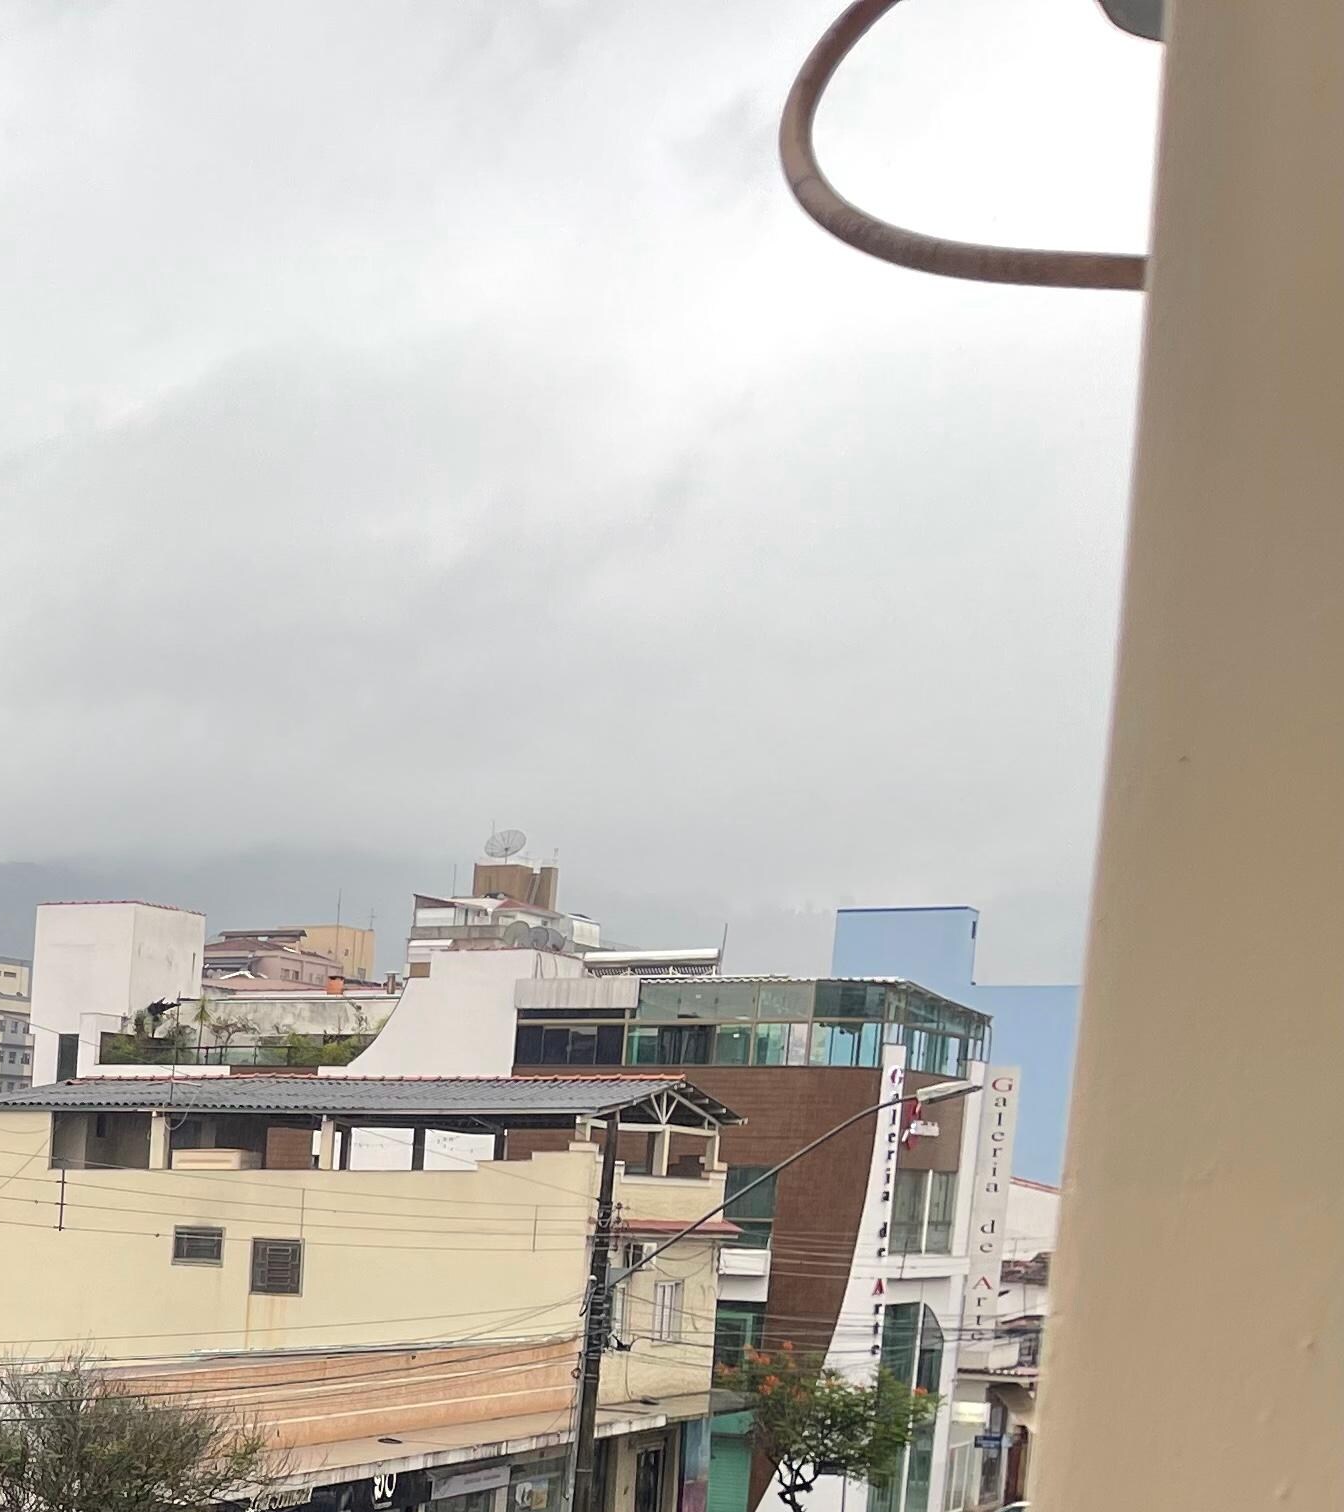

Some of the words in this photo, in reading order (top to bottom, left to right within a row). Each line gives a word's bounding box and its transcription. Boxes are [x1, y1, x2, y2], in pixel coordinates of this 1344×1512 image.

[881, 1066, 904, 1202] Galeria
[985, 1077, 1014, 1193] Galeria
[876, 1220, 888, 1257] de
[979, 1220, 996, 1253] de
[870, 1277, 885, 1356] Arte
[971, 1275, 993, 1340] Arte
